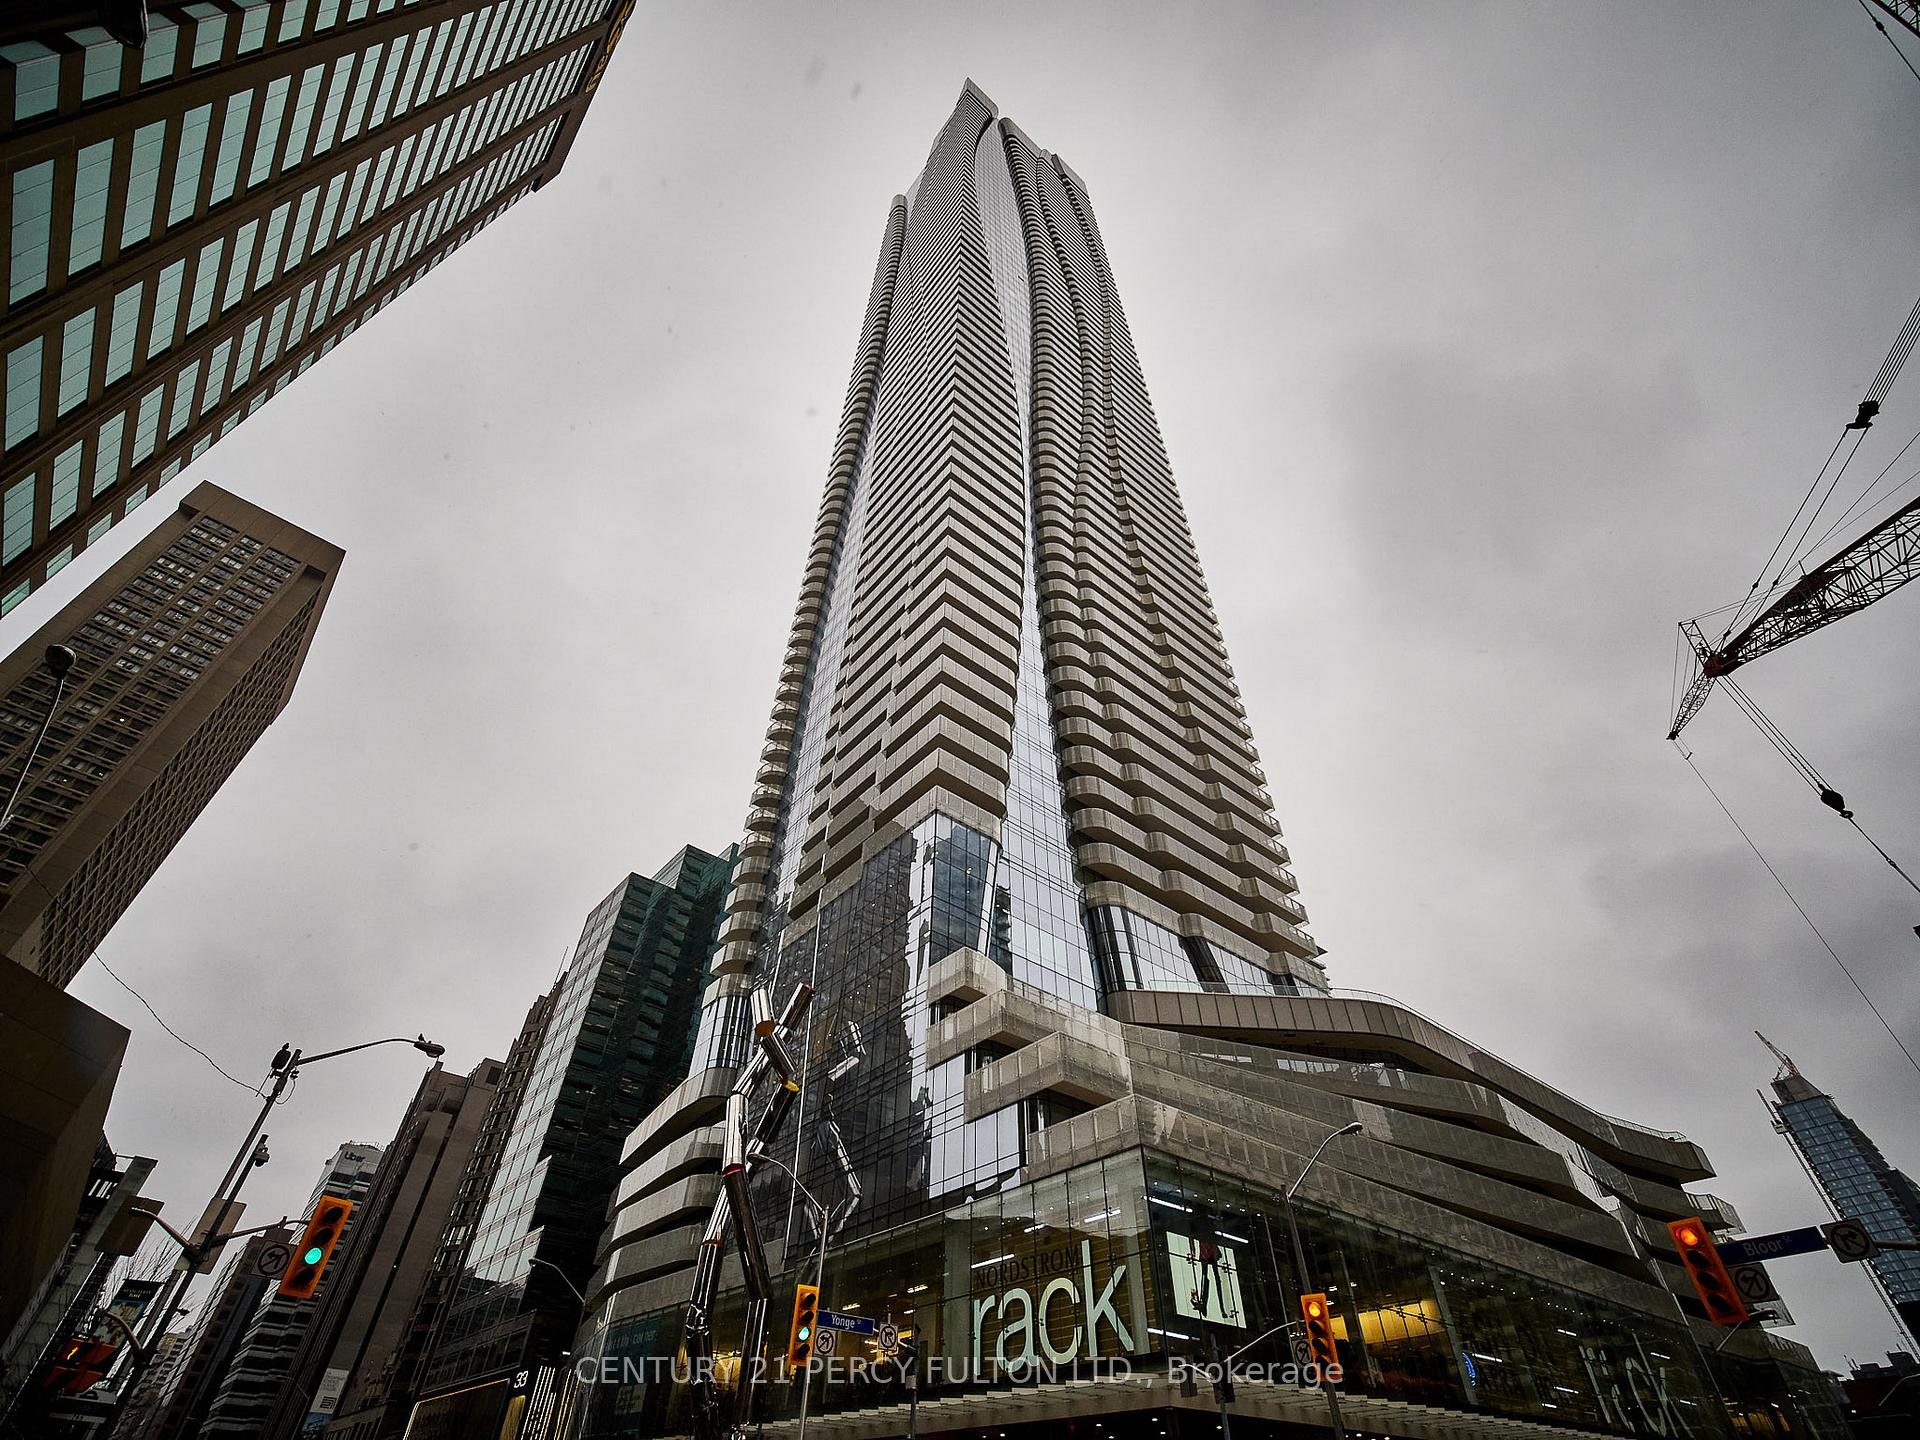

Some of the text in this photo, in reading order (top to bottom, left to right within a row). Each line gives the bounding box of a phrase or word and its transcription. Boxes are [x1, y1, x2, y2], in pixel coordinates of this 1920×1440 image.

[344, 1151, 366, 1162] Uber
[1741, 1237, 1782, 1257] Bloor
[975, 1243, 1081, 1289] NORDSTROM
[973, 1239, 1135, 1376] rack
[831, 1314, 855, 1330] Yonge
[513, 1370, 529, 1388] 33
